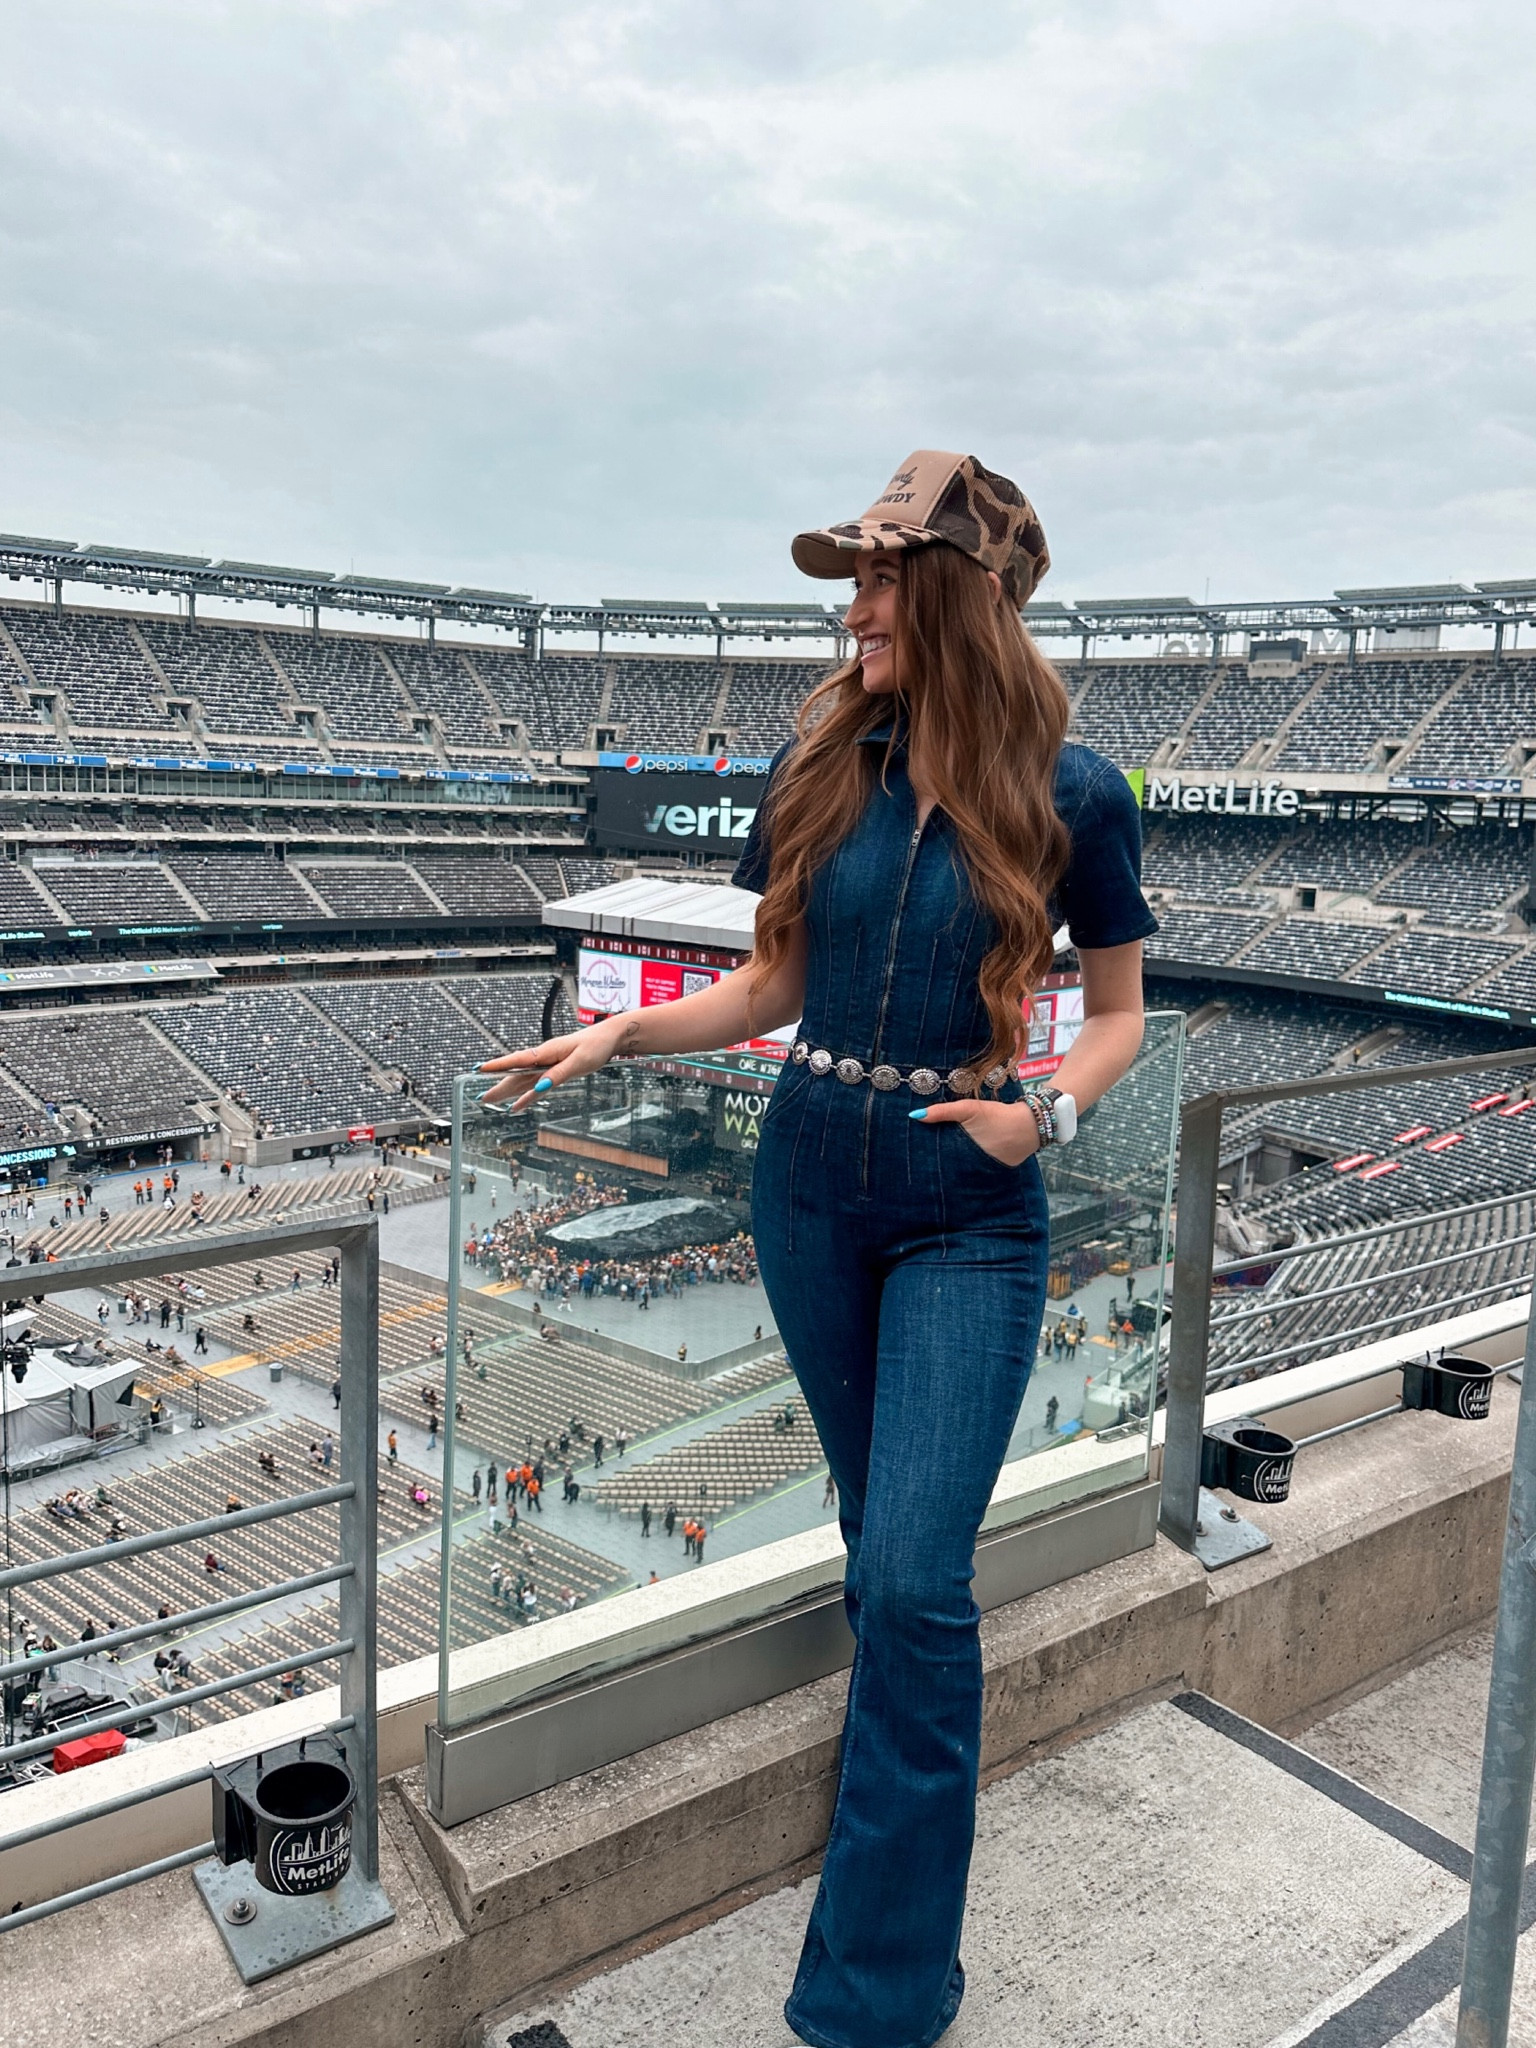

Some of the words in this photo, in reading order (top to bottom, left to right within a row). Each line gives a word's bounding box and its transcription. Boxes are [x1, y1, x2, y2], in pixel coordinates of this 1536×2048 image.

[645, 758, 688, 773] pepsi
[732, 762, 770, 776] peps
[1148, 777, 1299, 816] MetLife
[644, 796, 758, 838] veriz
[158, 963, 194, 972] MetLife
[15, 971, 55, 981] MetLife
[760, 1063, 782, 1076] NIG
[1018, 1059, 1058, 1077] utherford
[724, 1110, 760, 1139] WA
[105, 1134, 148, 1147] RESTROOMS
[156, 1125, 205, 1139] CONCESSIONS
[0, 1147, 57, 1166] ONCESSIONS
[1265, 1482, 1289, 1494] Met
